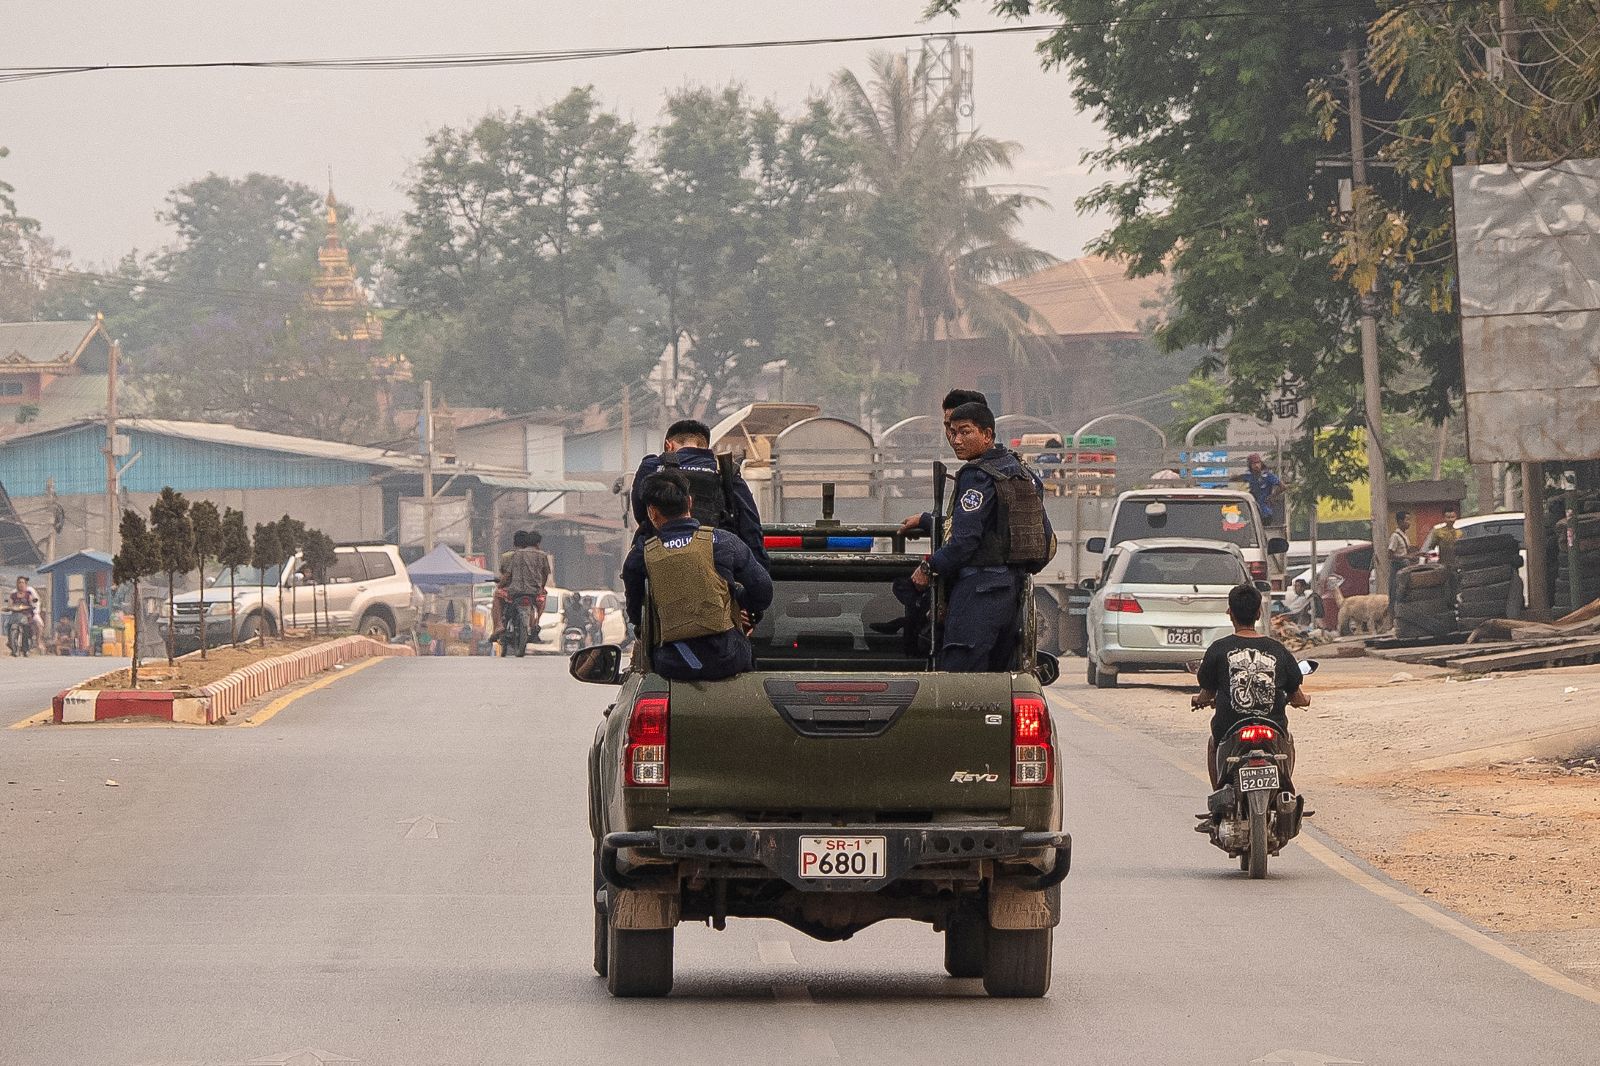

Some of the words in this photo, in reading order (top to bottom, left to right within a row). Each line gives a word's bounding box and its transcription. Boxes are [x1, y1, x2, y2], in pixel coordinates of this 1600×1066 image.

[1168, 633, 1201, 643] 02810
[1242, 777, 1277, 790] 52072
[826, 839, 861, 850] SR-1
[802, 851, 878, 875] P6801
